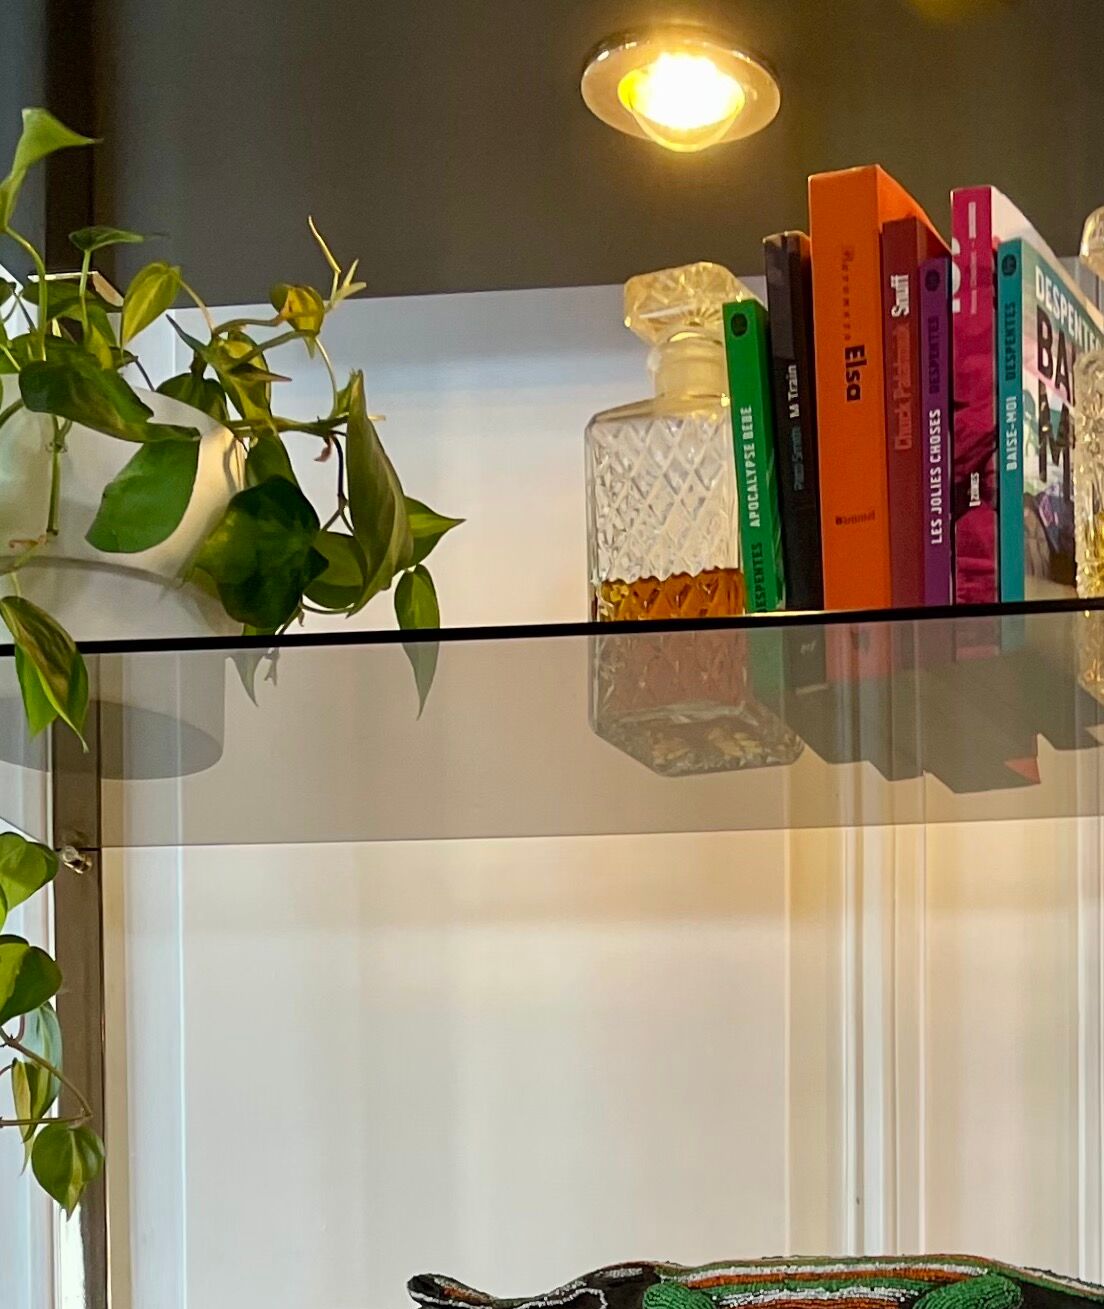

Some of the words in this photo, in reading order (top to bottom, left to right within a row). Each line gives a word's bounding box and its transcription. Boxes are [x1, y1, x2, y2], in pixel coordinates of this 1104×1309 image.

[890, 273, 910, 318] Snuff
[1004, 302, 1017, 382] DESPENTES
[1037, 304, 1075, 406] BA
[786, 364, 799, 400] Train
[844, 344, 867, 403] Elsa
[929, 408, 941, 463] CHOSES
[1005, 395, 1018, 471] BAISE-MOI
[744, 442, 760, 528] APOCALYPSE
[930, 466, 942, 512] JOLIES
[931, 517, 943, 544] LES
